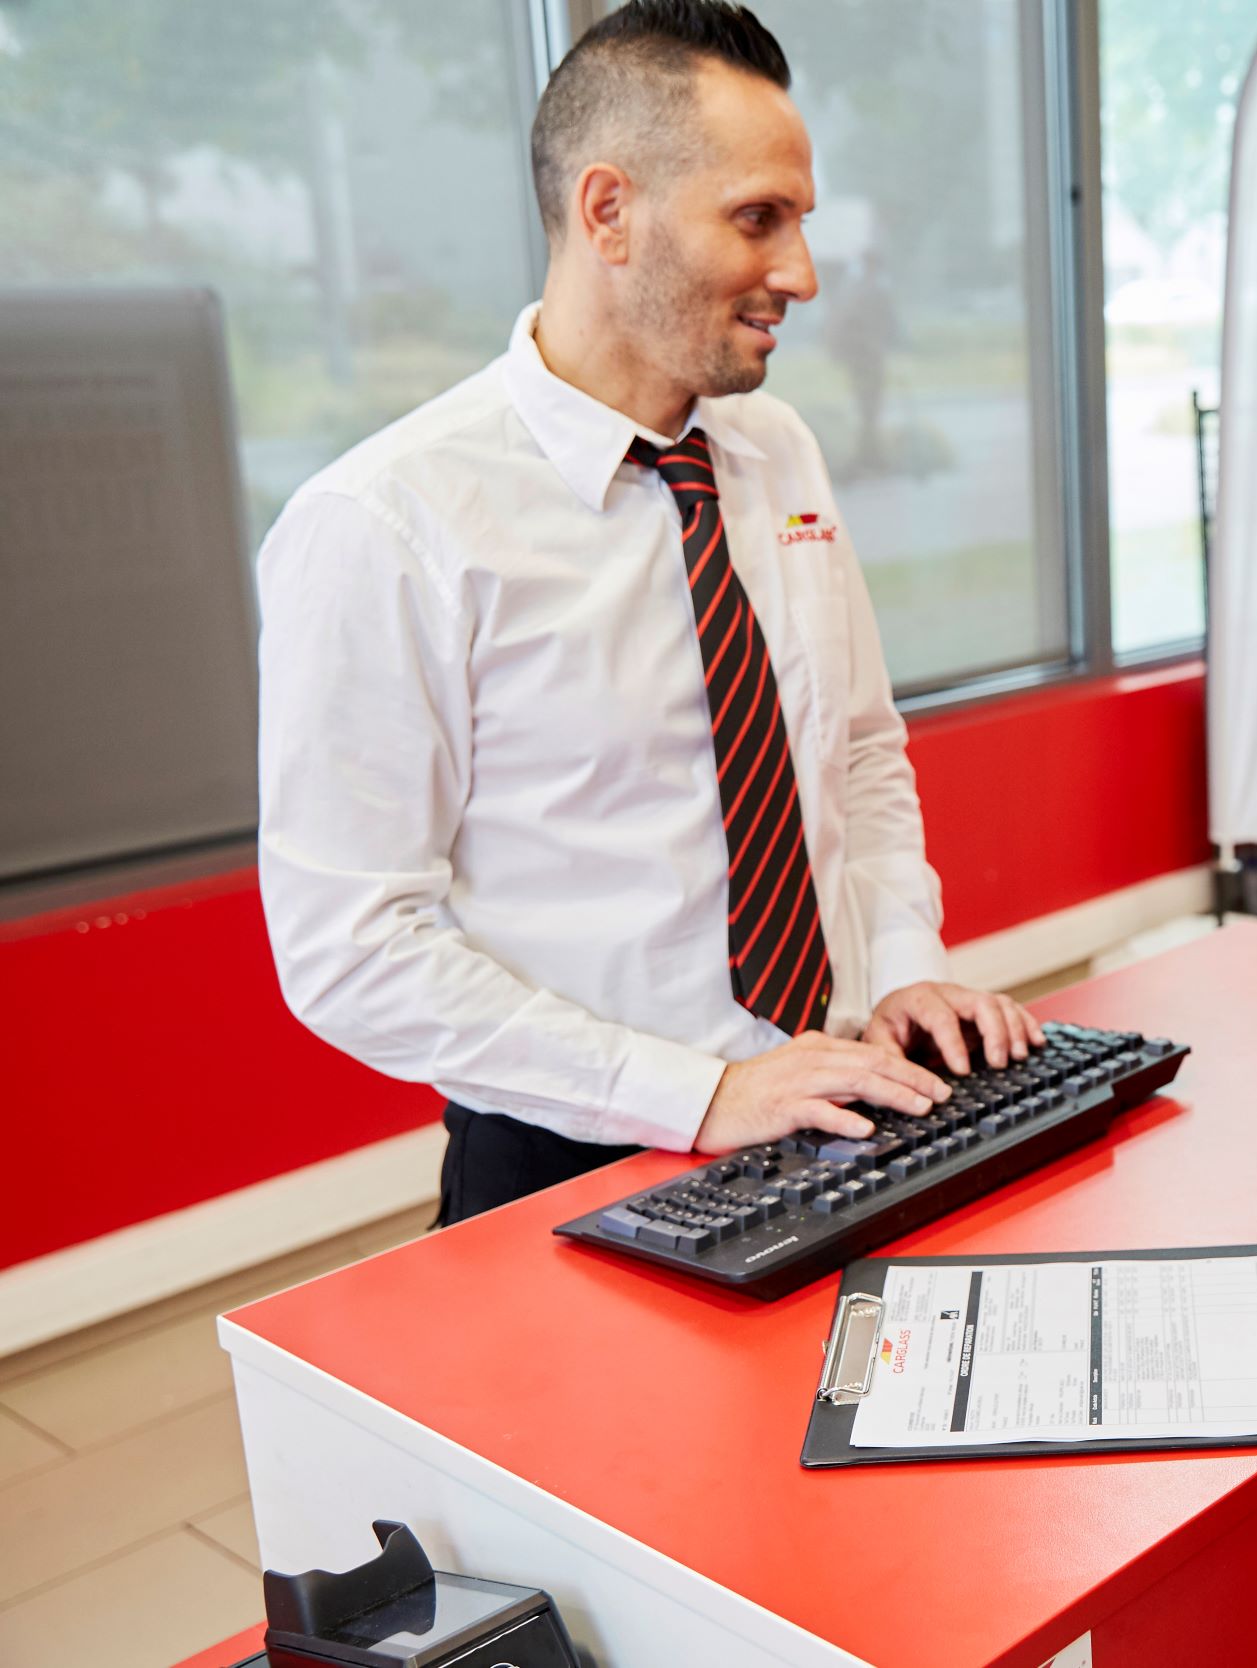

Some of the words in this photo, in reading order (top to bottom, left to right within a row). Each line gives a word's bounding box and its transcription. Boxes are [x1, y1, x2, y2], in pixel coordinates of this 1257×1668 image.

[893, 1329, 911, 1374] CARGLASS
[962, 1324, 974, 1353] REPARATION
[959, 1360, 970, 1377] ORDRE
